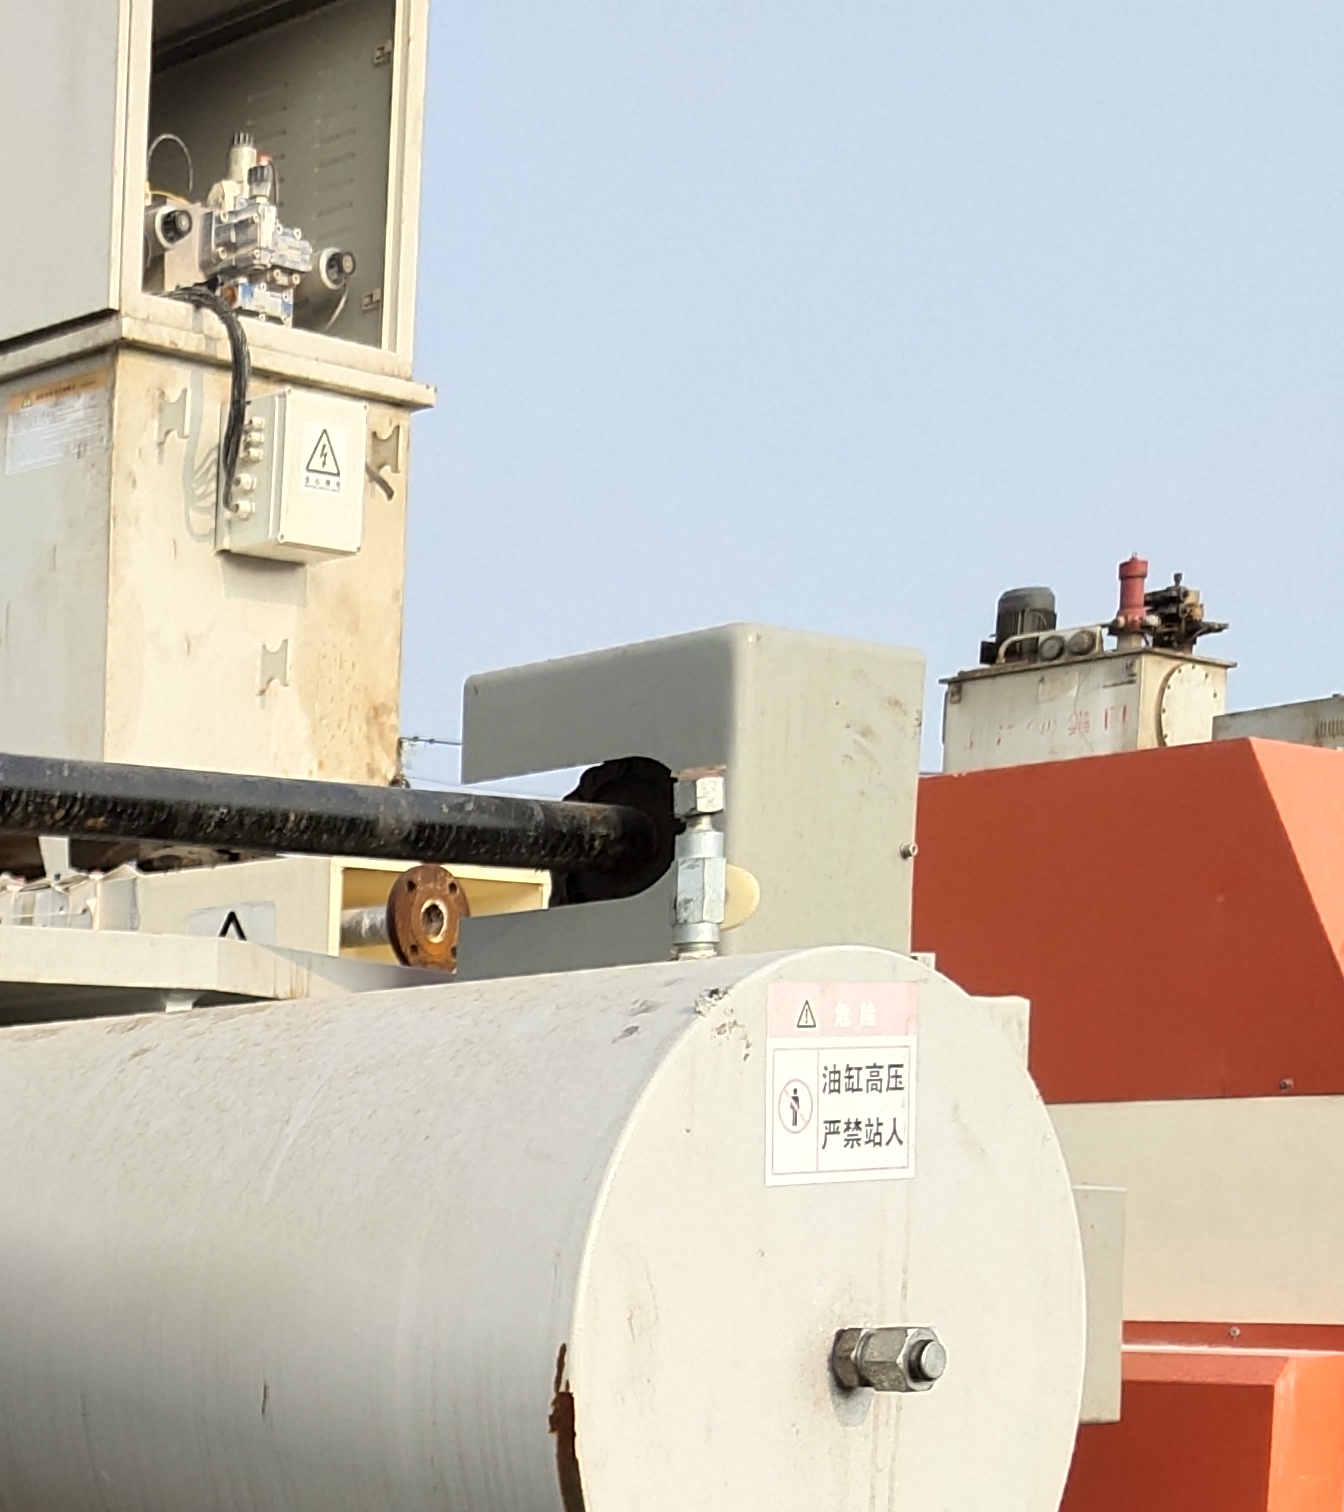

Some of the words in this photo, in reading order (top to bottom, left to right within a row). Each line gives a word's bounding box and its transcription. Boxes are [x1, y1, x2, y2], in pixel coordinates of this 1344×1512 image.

[833, 1001, 878, 1028] 危险
[821, 1062, 905, 1095] 油缸高压
[821, 1116, 904, 1150] 严禁站人
